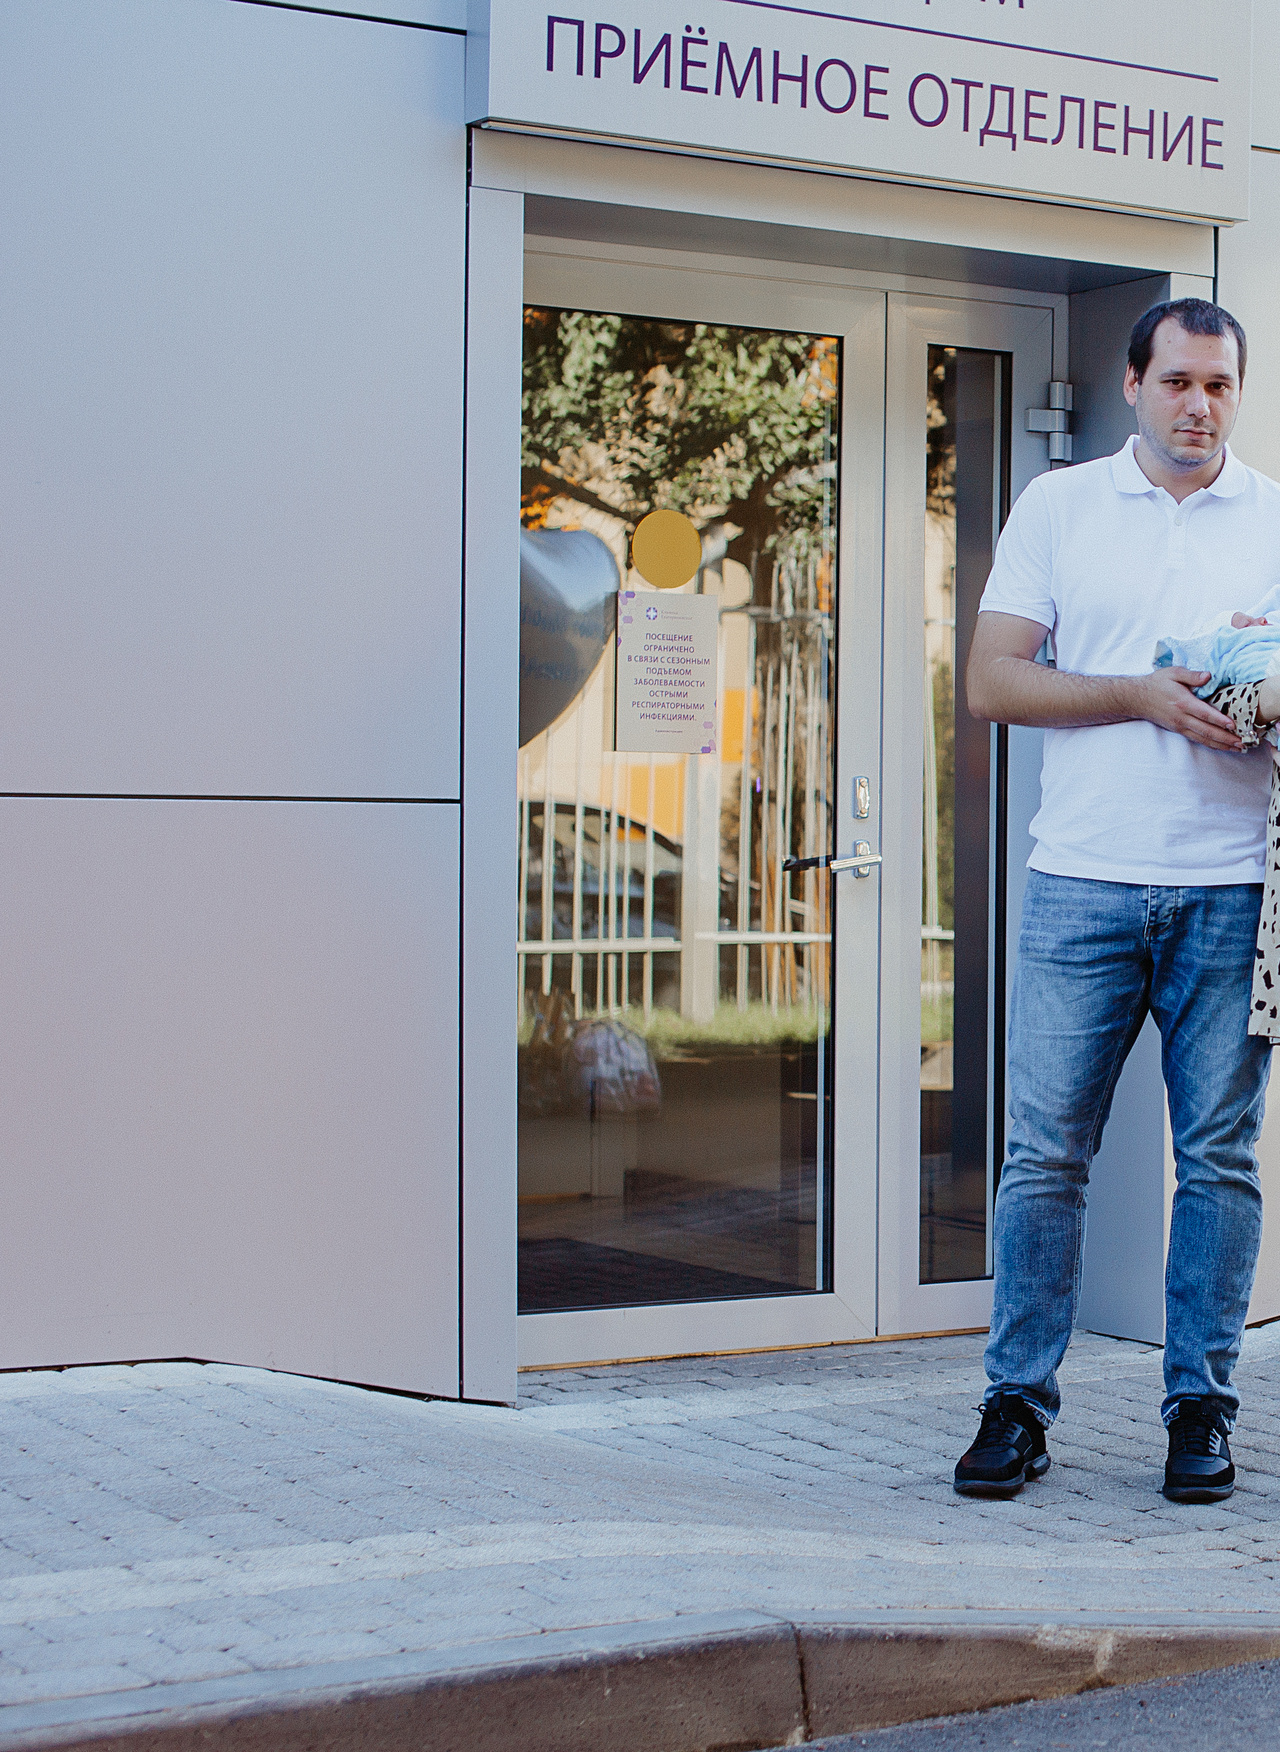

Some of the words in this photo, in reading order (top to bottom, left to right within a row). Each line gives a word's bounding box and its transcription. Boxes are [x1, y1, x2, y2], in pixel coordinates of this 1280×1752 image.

[547, 15, 890, 121] ПРИЁМНОЕ
[908, 72, 1224, 171] ОТДЕЛЕНИЕ
[645, 632, 693, 642] ПОСЕЩЕНИЕ
[643, 644, 695, 653] ОГРАНИЧЕНО
[627, 654, 632, 662] В
[633, 655, 659, 663] СВЯЗИ
[660, 656, 665, 664] С
[666, 656, 710, 665] СЕЗОННЫМ
[645, 667, 692, 676] ПОДЪЕМОМ
[633, 678, 705, 687] ЗАБОЛЕВАЕМОСТИ
[649, 690, 688, 698] ОСТРЫМИ
[631, 701, 705, 710] РЕСПИРАТОРНЫМИ
[639, 712, 697, 721] ИНФЕКЦИЯМИ.
